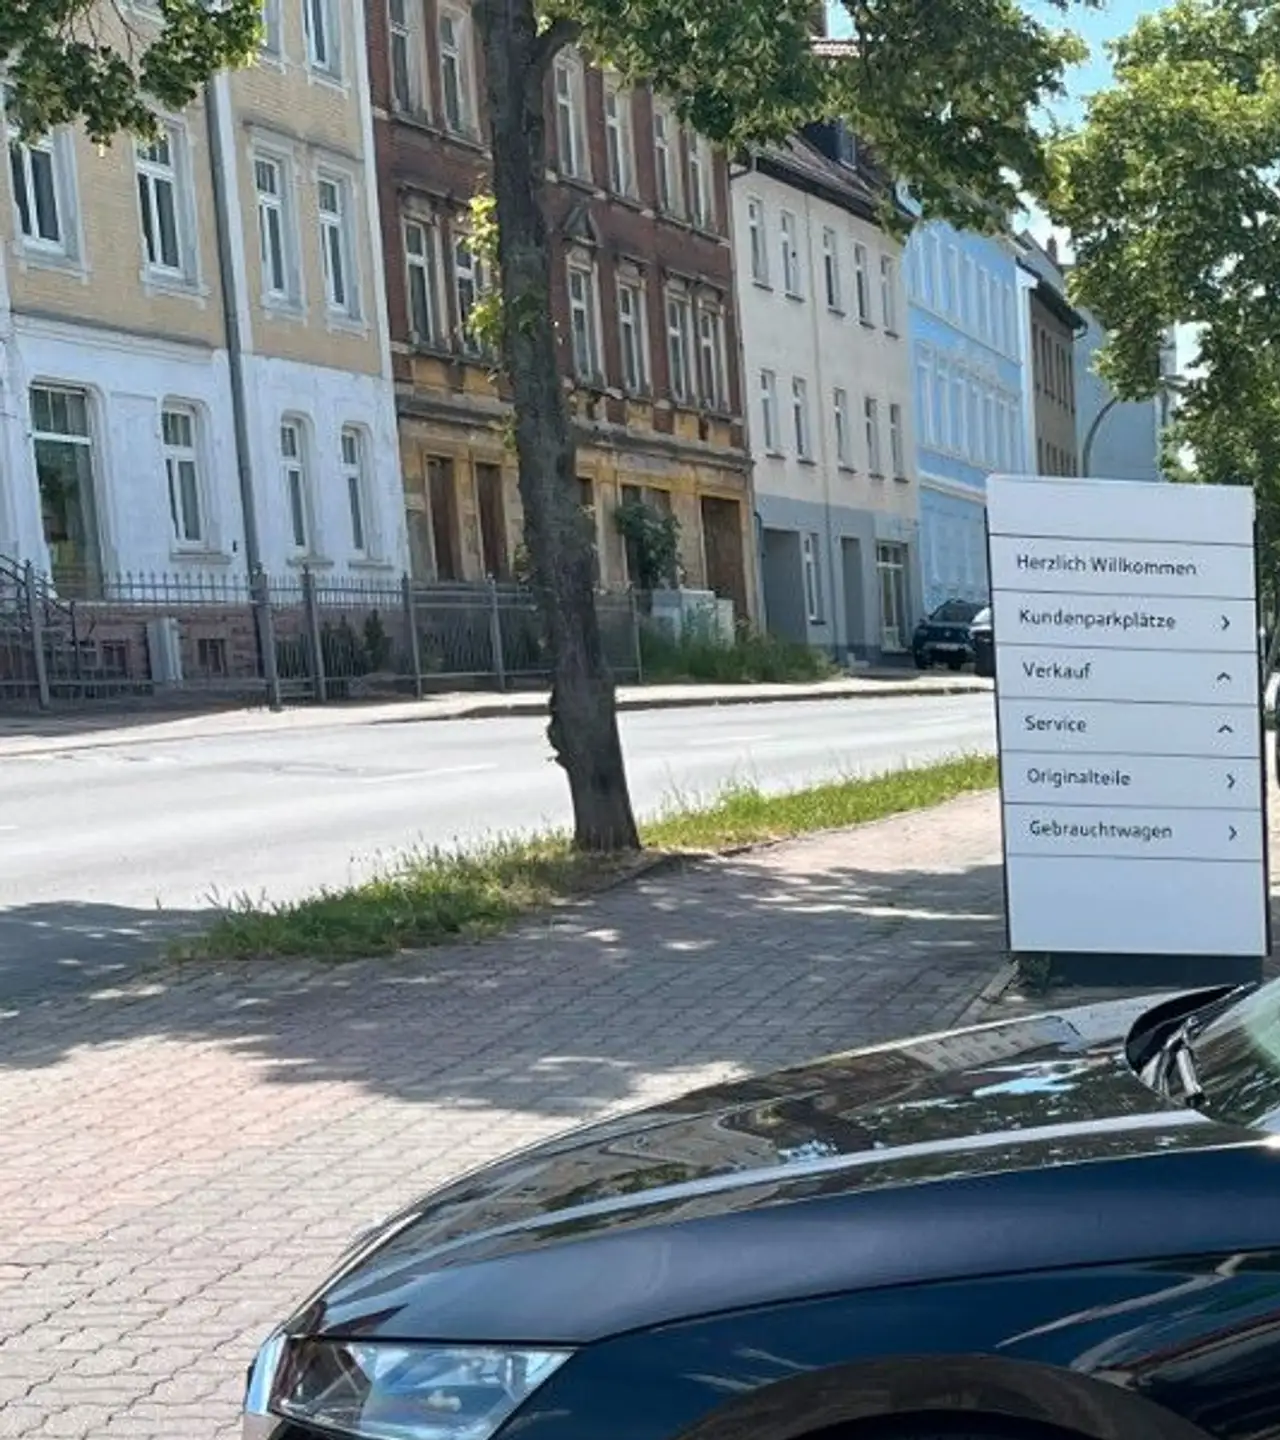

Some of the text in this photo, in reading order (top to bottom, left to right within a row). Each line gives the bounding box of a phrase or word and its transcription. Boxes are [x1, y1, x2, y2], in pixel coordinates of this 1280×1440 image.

[1016, 553, 1197, 577] Herzlich Willkommen
[1018, 607, 1177, 633] Kundenparkplätze
[1022, 661, 1092, 680] Verkauf
[1024, 714, 1087, 733] Service
[1026, 766, 1132, 790] Originalteile
[1028, 818, 1173, 845] Gebrauchtwagen
